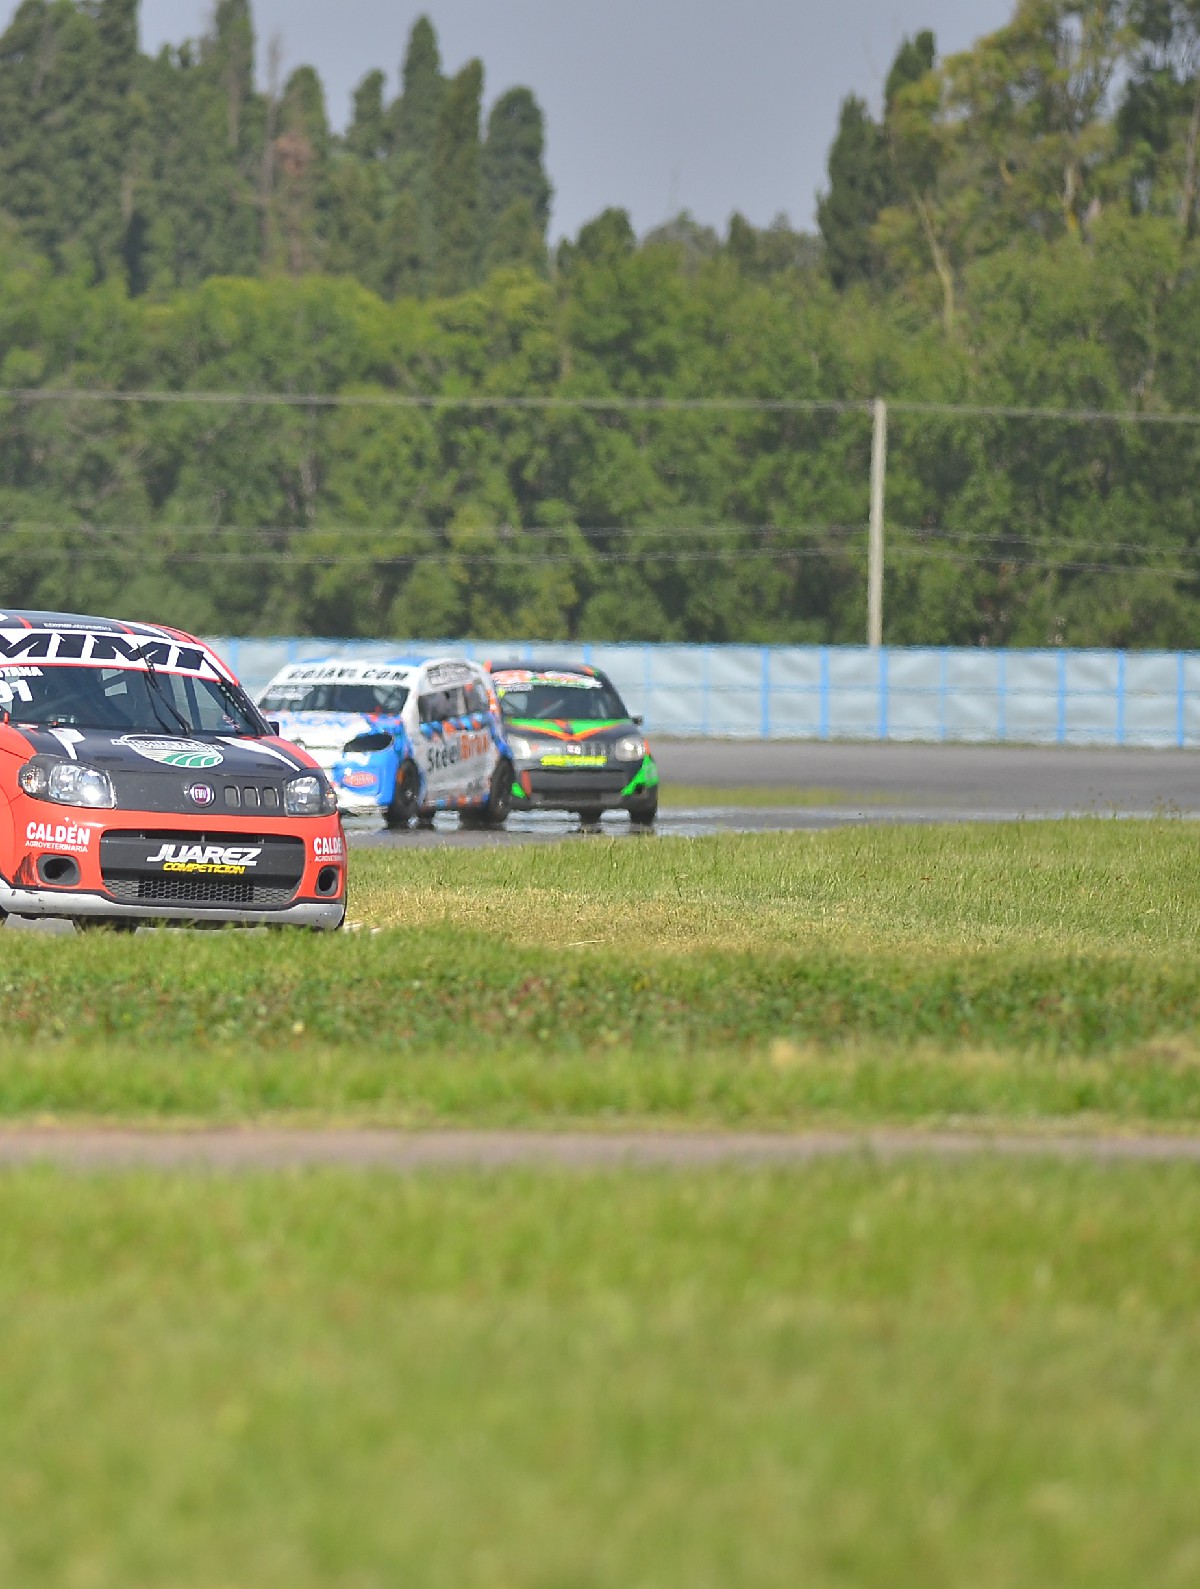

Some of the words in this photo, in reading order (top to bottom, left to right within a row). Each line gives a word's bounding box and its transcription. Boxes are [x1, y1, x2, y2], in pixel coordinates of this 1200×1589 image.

[147, 844, 262, 866] JUAREZ
[313, 837, 342, 855] CALDE
[163, 862, 245, 874] COMPETICION
